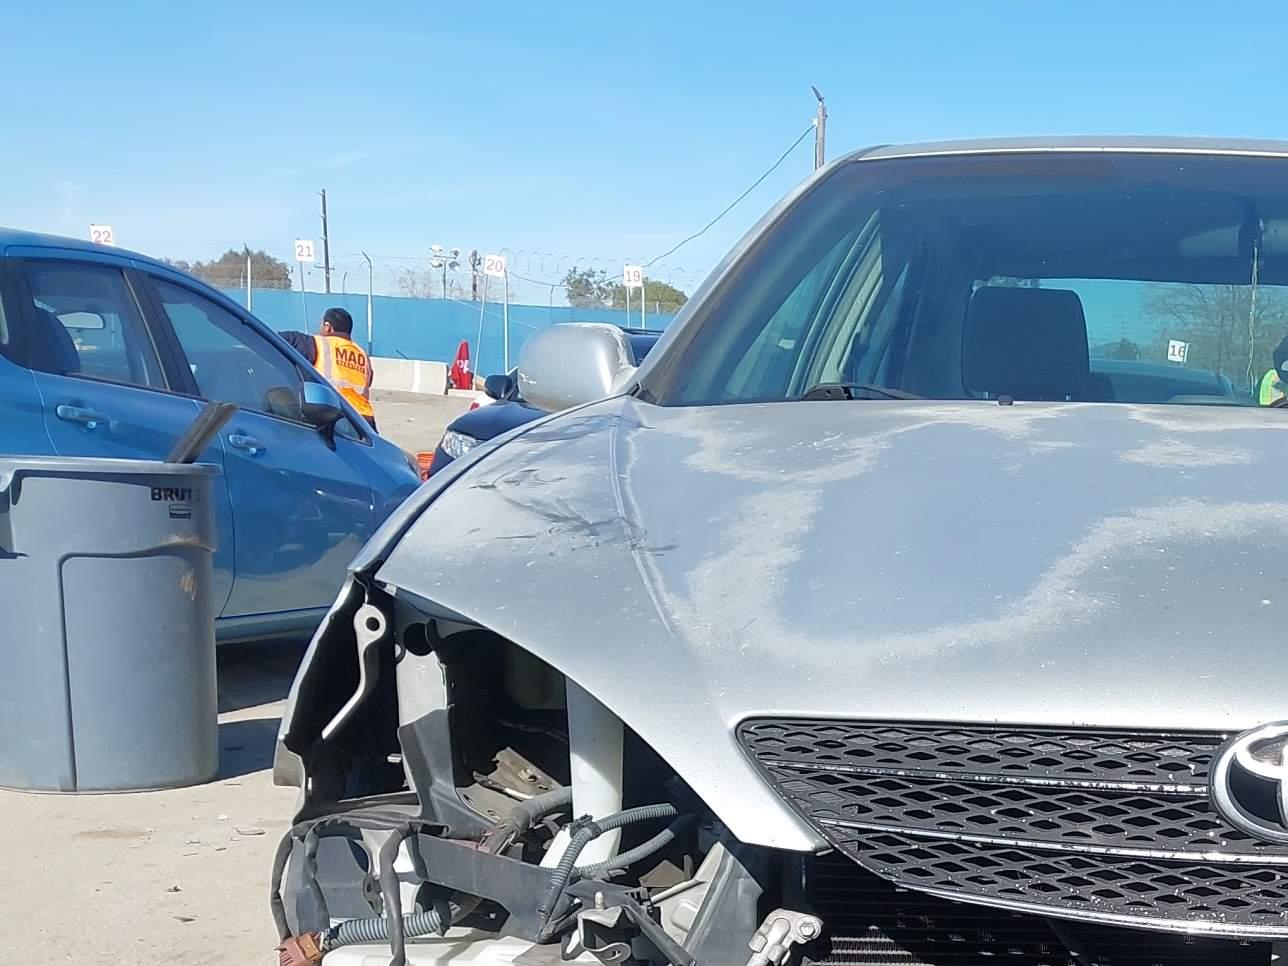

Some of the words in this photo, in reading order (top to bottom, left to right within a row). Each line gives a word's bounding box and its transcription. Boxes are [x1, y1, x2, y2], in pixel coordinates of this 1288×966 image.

[92, 230, 113, 243] 22
[296, 245, 312, 257] 21
[486, 258, 503, 272] 20
[625, 270, 641, 282] 19
